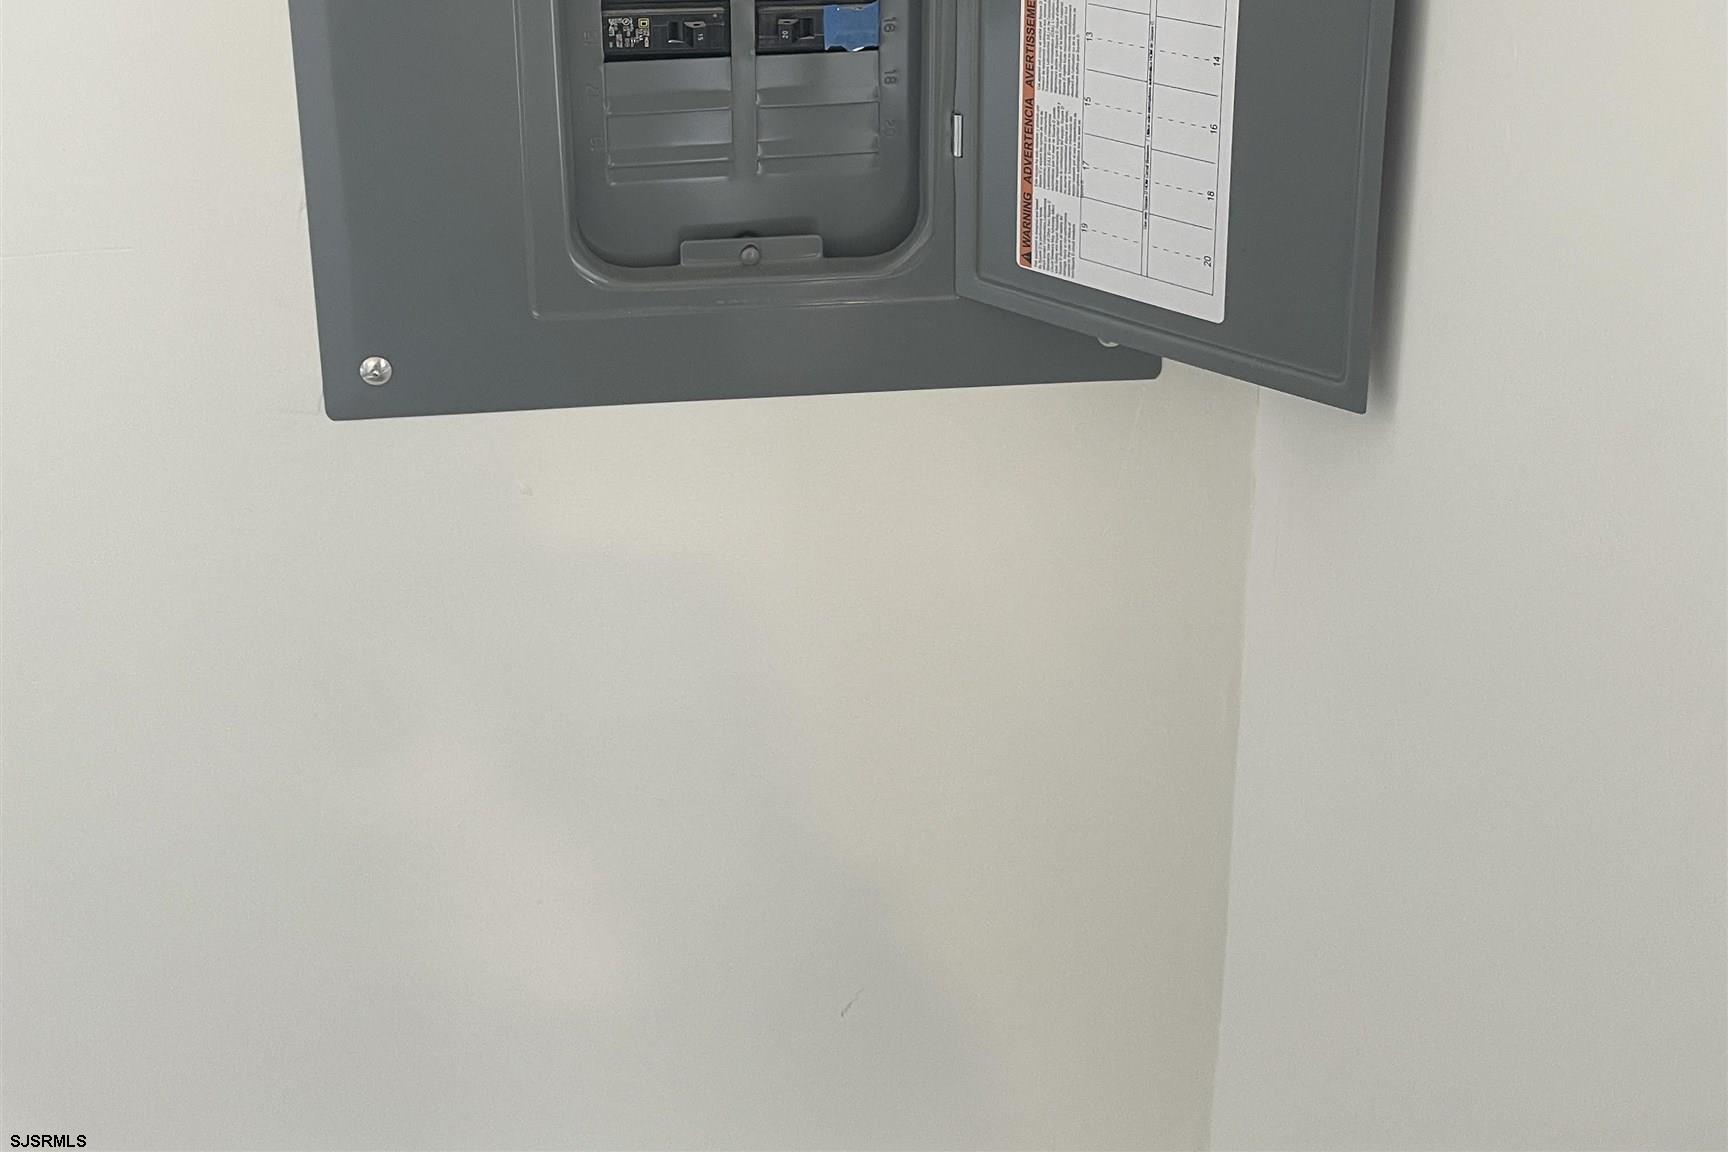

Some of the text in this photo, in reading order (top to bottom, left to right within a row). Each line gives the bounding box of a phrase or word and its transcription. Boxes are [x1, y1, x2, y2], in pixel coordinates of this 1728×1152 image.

[884, 17, 896, 32] 16
[782, 30, 789, 39] 20
[1086, 32, 1093, 41] 13
[1213, 56, 1221, 66] 14
[884, 69, 896, 85] 18
[1084, 96, 1091, 106] 15
[1210, 124, 1218, 134] 16
[1023, 98, 1034, 184] ADVERTENCIA
[1207, 191, 1215, 201] 18
[1022, 192, 1032, 248] WARNING
[1082, 223, 1088, 232] 19
[1204, 256, 1212, 267] 20
